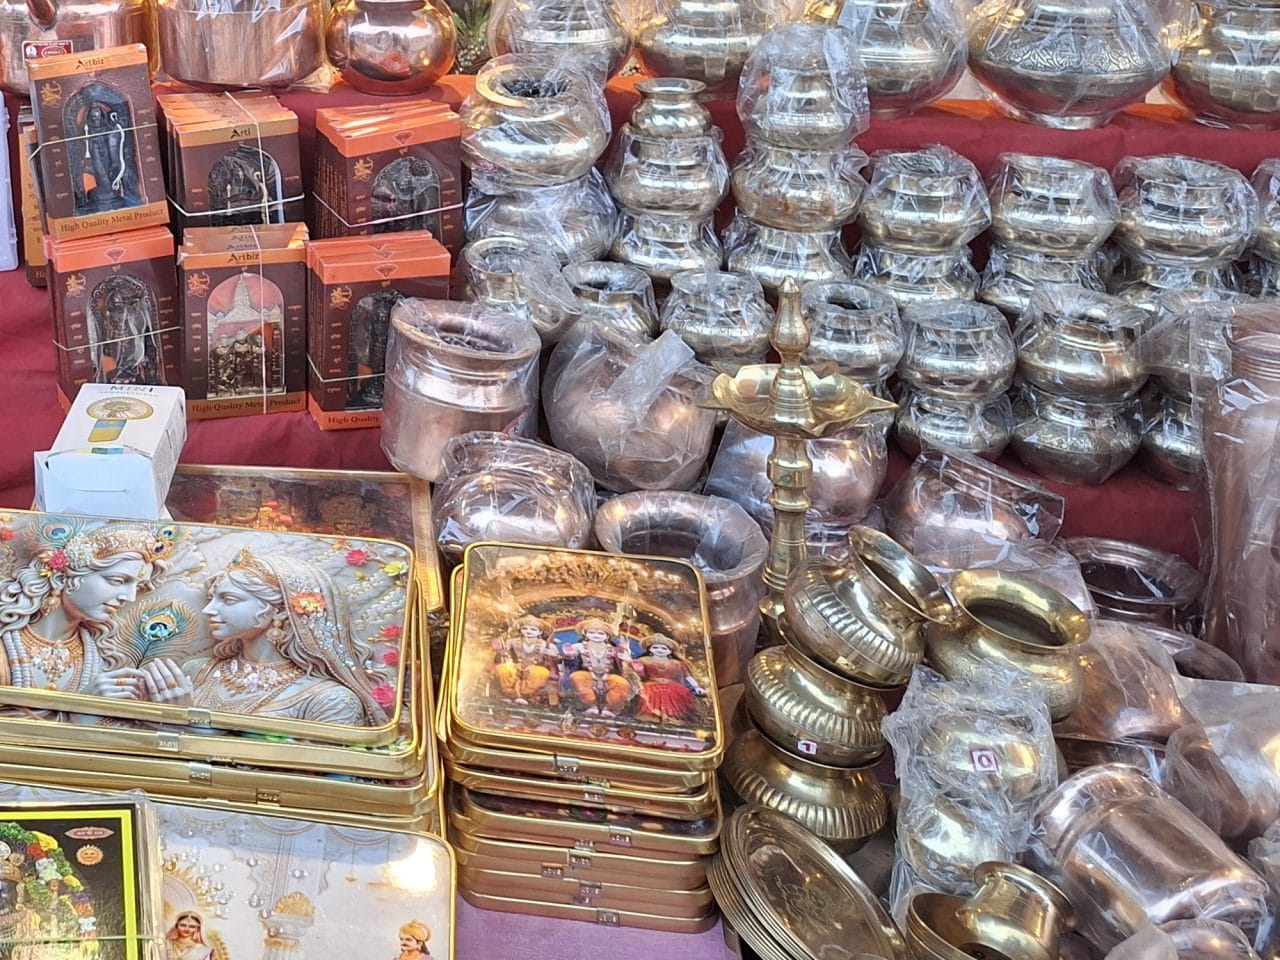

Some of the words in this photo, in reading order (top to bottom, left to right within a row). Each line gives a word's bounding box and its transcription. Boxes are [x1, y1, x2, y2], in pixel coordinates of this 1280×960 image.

[76, 58, 105, 70] Artbiz
[60, 222, 81, 234] High
[81, 219, 111, 232] Quality
[111, 214, 133, 225] Metal
[133, 208, 164, 221] Product
[228, 252, 261, 263] Artbiz
[192, 403, 212, 414] High
[213, 401, 244, 413] Quality
[244, 400, 266, 409] Meta
[270, 397, 301, 407] Product
[328, 415, 349, 424] High
[351, 414, 379, 425] Quality
